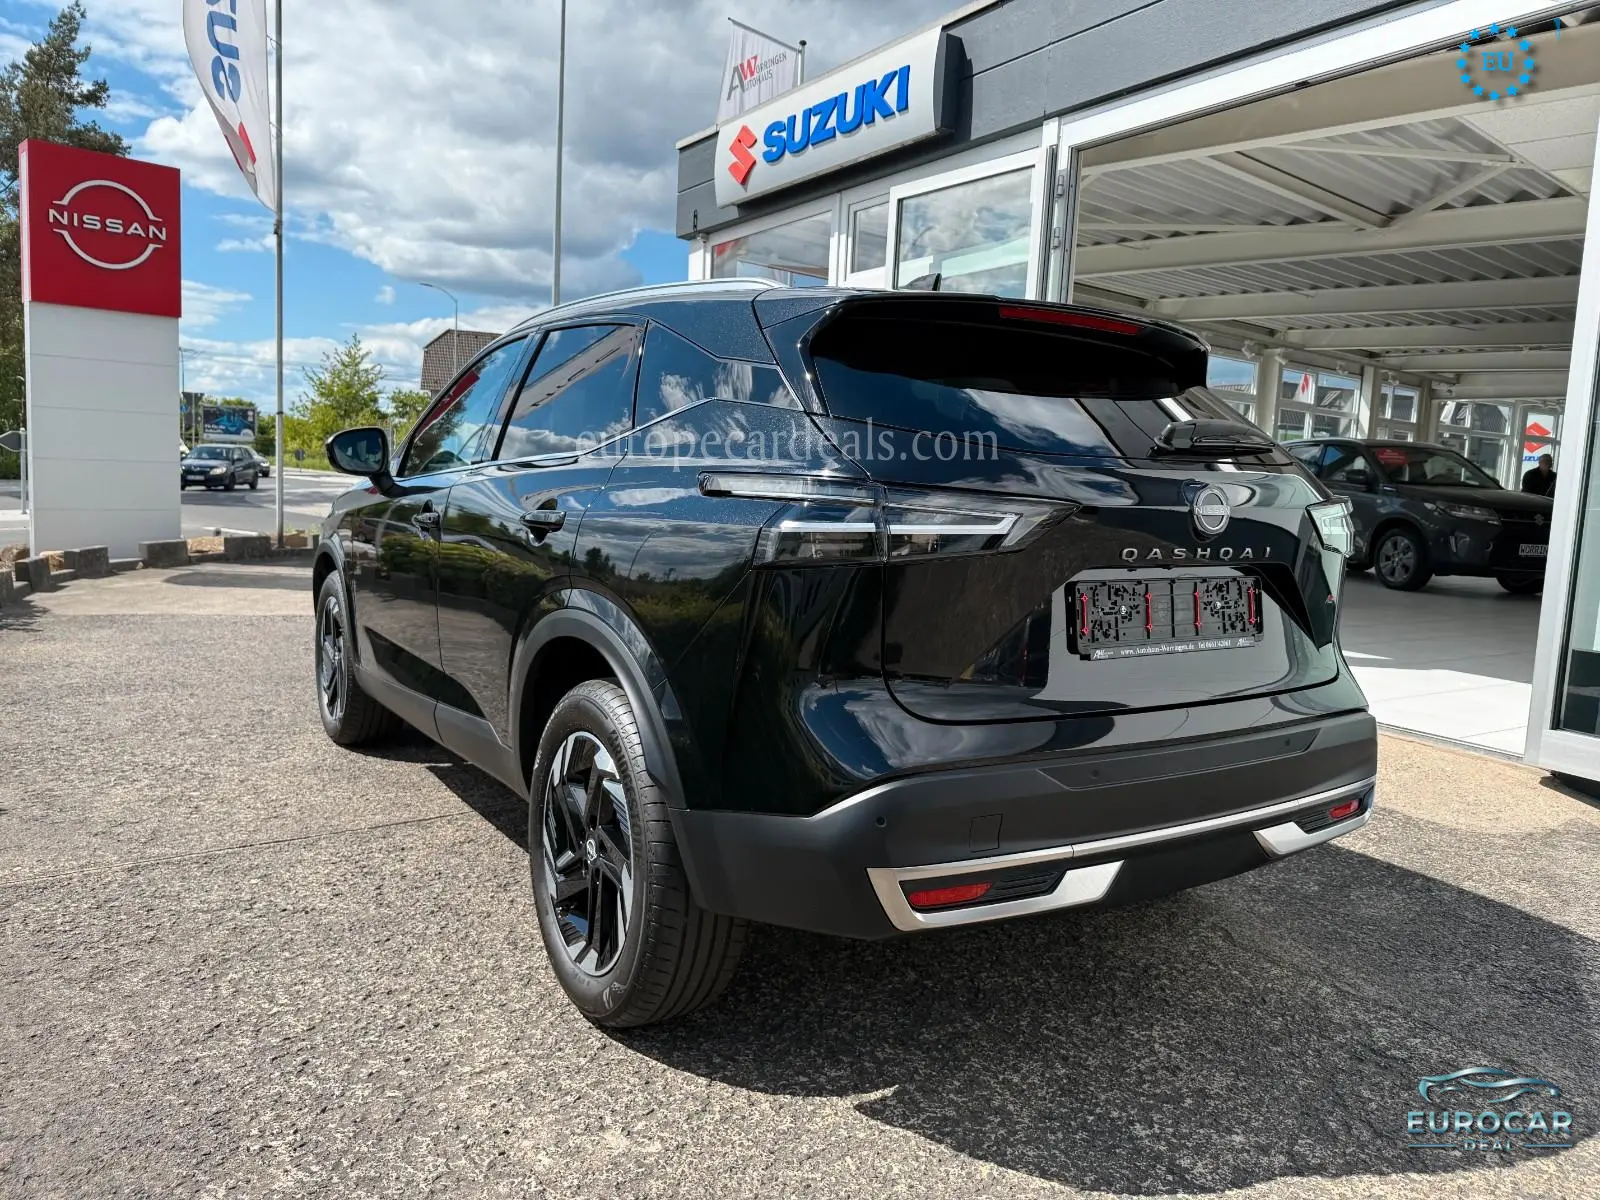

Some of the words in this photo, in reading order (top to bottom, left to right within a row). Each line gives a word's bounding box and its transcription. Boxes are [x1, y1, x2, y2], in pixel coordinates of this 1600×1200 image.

[762, 64, 911, 164] SUZUKI
[48, 208, 167, 241] NISSAN
[1121, 546, 1271, 563] QASHQAI
